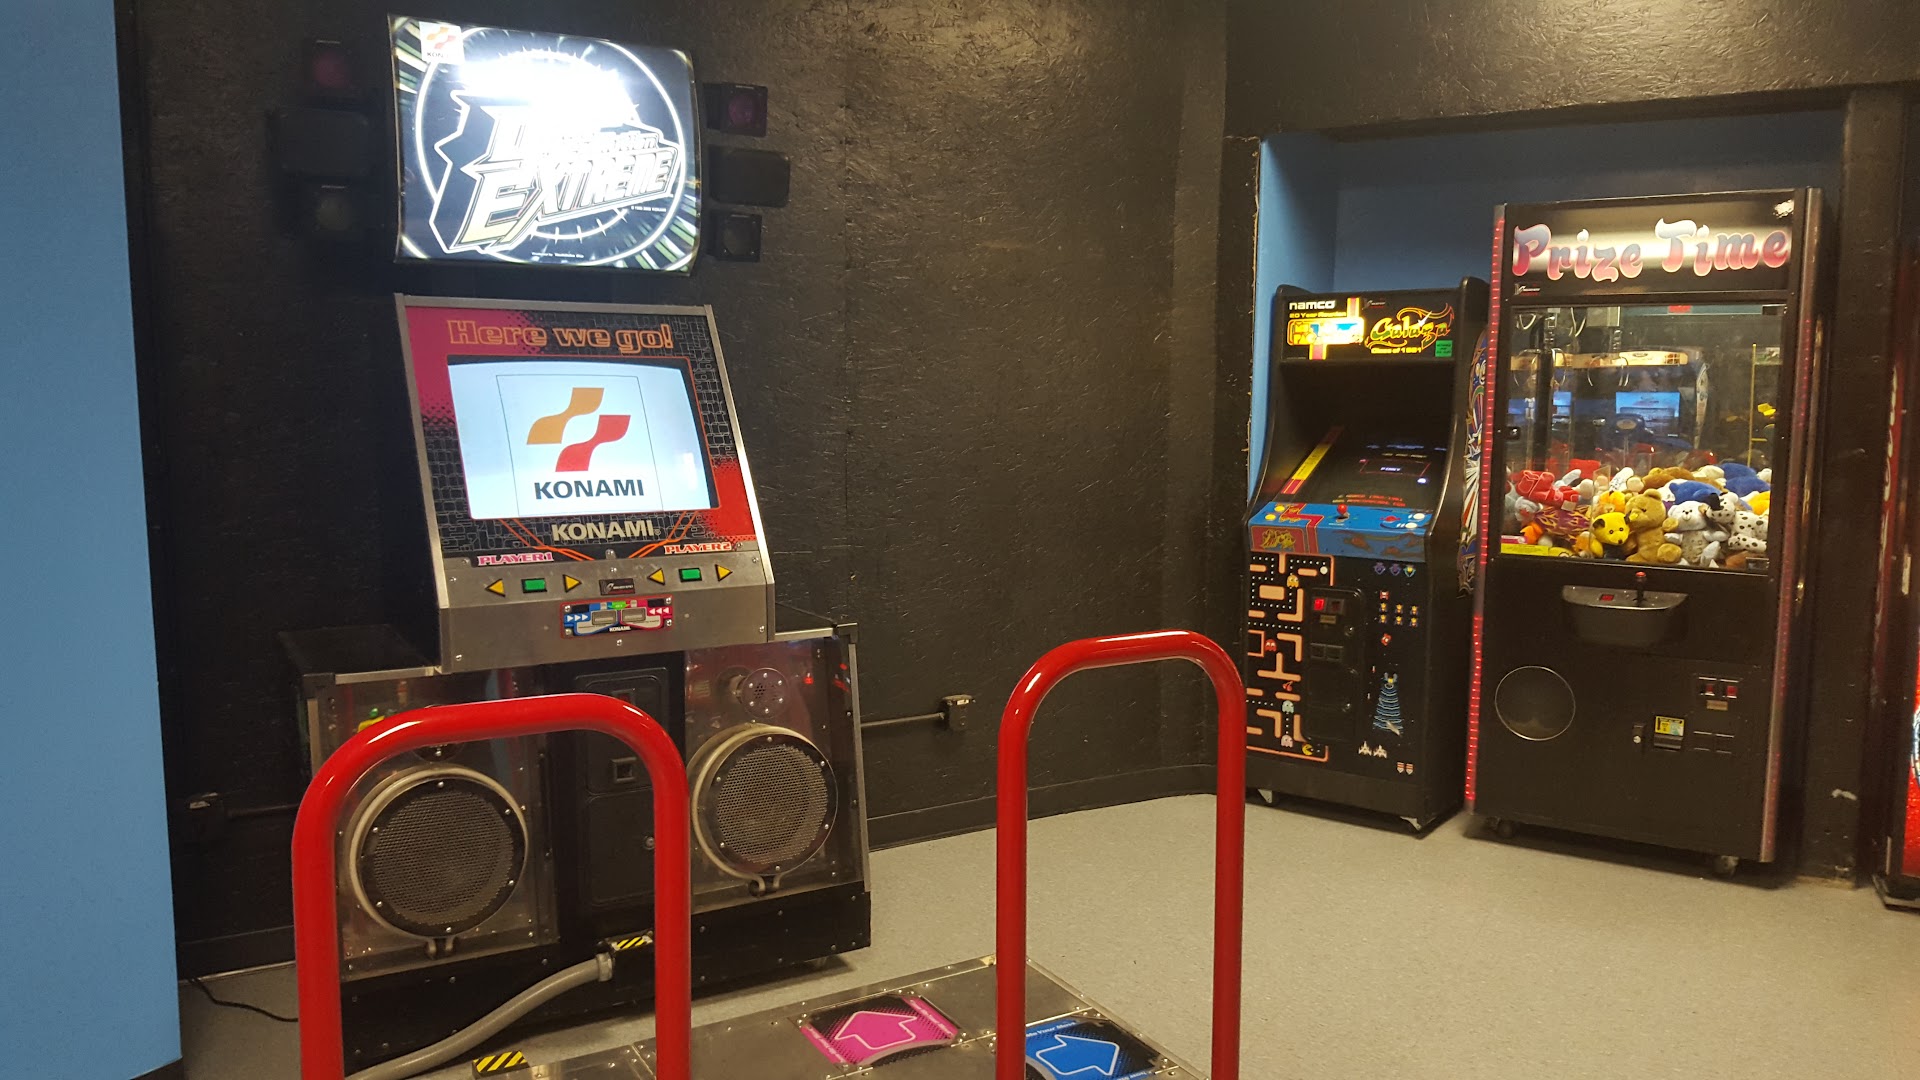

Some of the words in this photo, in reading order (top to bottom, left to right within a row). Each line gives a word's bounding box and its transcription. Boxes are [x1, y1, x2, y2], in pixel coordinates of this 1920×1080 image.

[455, 149, 677, 248] EXTREME
[1512, 223, 1643, 282] Prize
[1655, 218, 1790, 277] Time
[1289, 300, 1336, 310] namco
[447, 320, 548, 347] Here
[553, 327, 611, 348] we
[616, 323, 674, 355] go!
[534, 479, 644, 500] KONAMI
[551, 519, 655, 542] KONAMI
